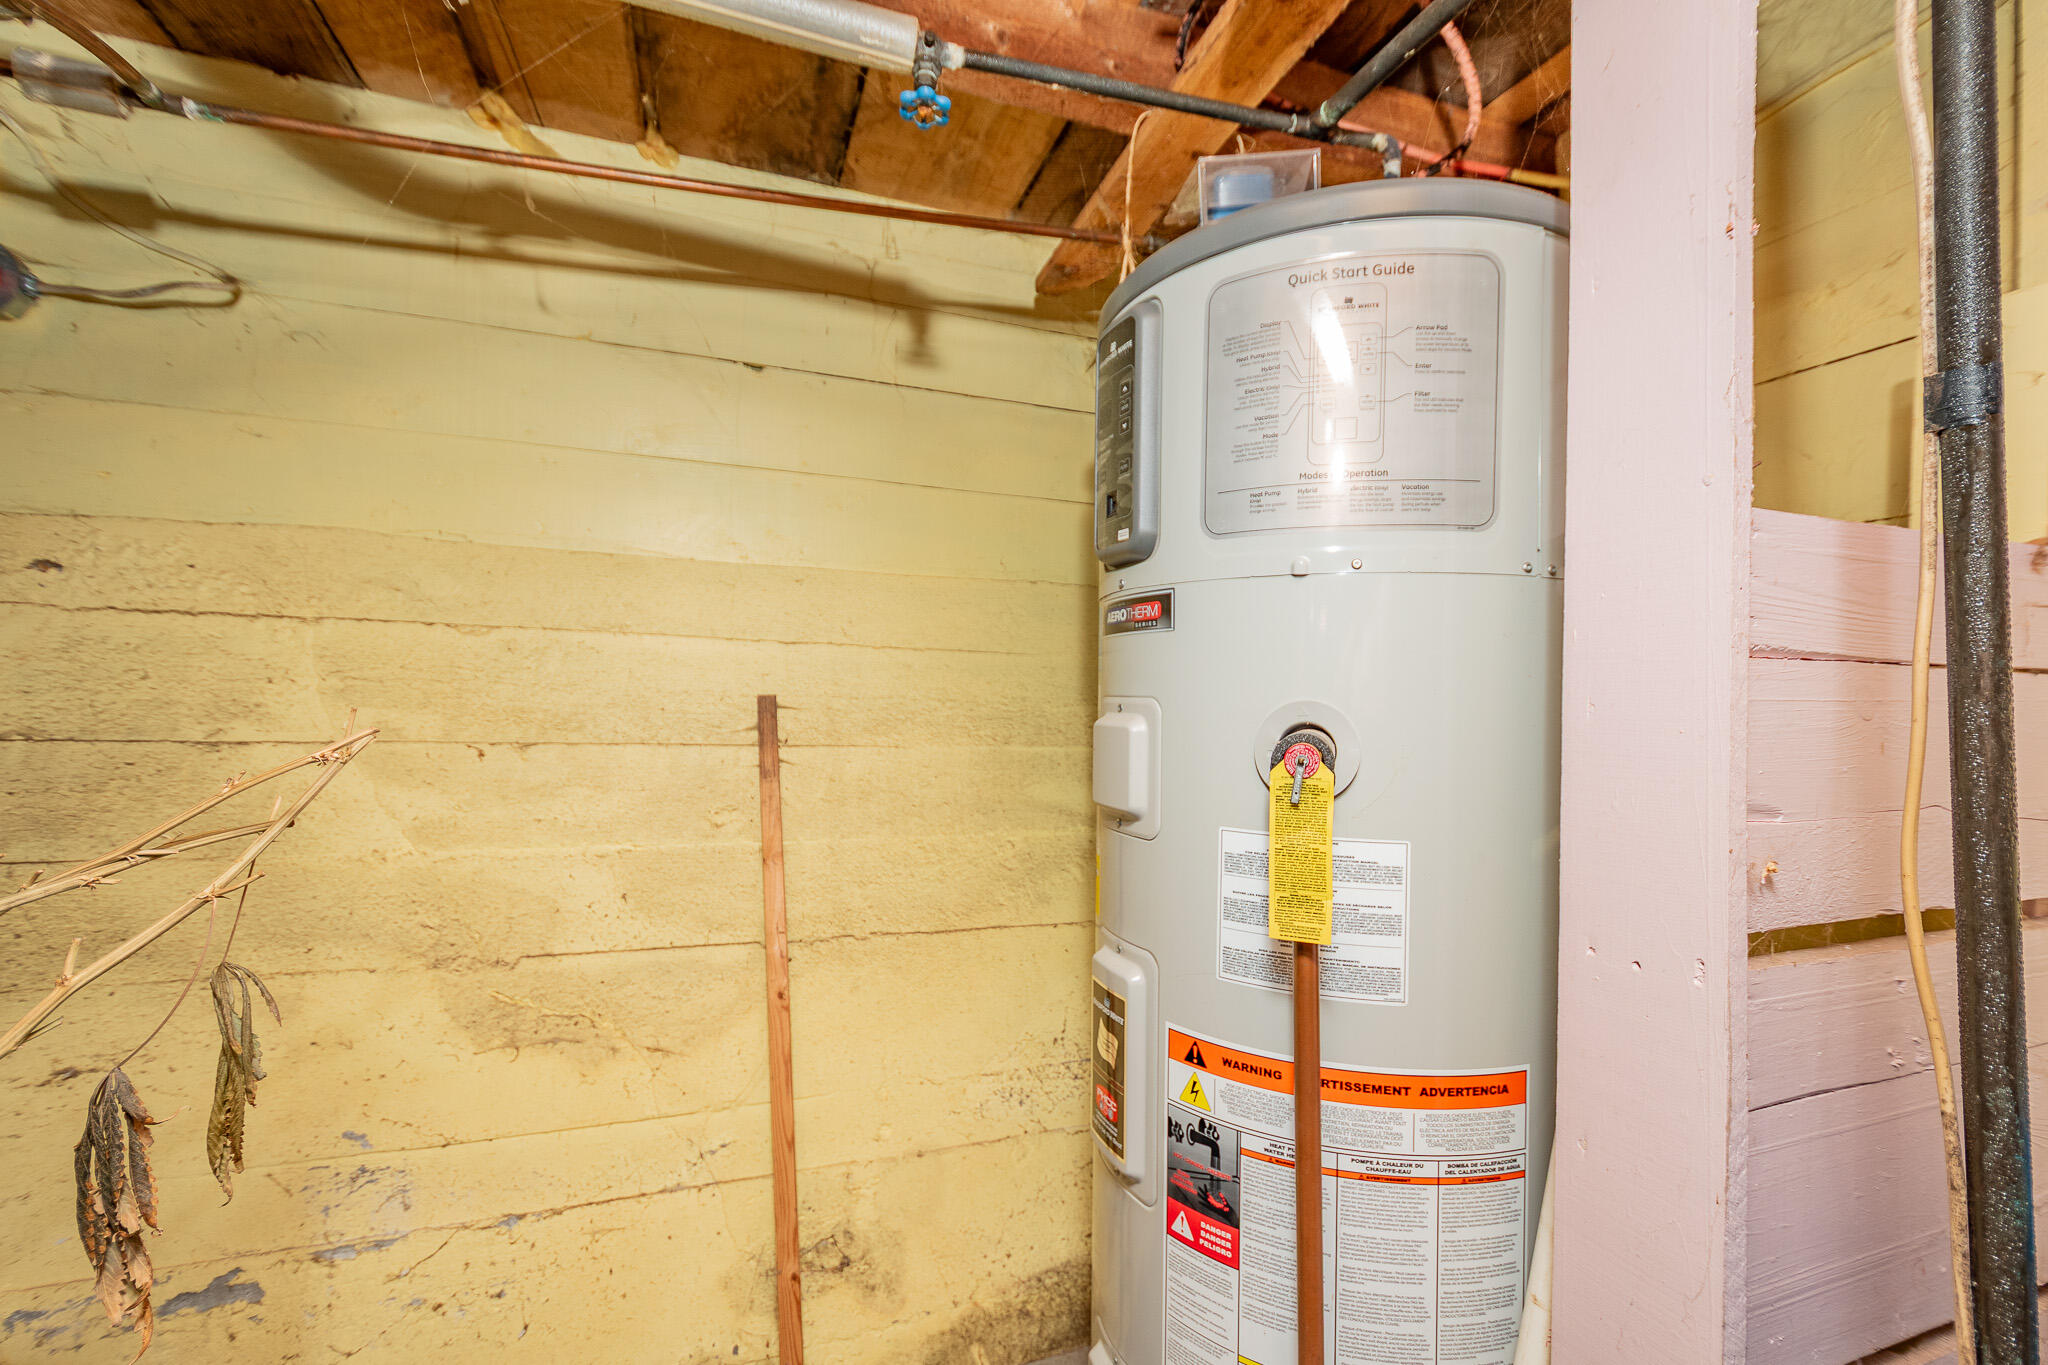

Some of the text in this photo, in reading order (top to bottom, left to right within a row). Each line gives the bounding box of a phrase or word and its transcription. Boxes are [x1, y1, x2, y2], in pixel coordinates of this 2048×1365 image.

[1288, 261, 1415, 287] Quick Start Guide
[1261, 364, 1280, 372] Hybrid
[1244, 386, 1264, 394] Electric
[1299, 472, 1329, 480] Modes
[1297, 487, 1319, 495] Hybrid
[1106, 603, 1160, 624] AEROTHERM
[1135, 620, 1157, 628] SERIES
[1221, 1056, 1282, 1081] WARNING
[1320, 1079, 1509, 1098] RTISSEMENT ADVERTENCIA
[1269, 1142, 1285, 1150] HEAT
[1263, 1147, 1284, 1157] WATER
[1351, 1158, 1374, 1166] POMPE
[1365, 1166, 1412, 1175] CHAUFFE-EAU
[1457, 1167, 1497, 1175] CALENTADOR
[1200, 1220, 1232, 1240] DANGER
[1200, 1230, 1232, 1249] DANGER
[1199, 1238, 1232, 1258] PELIGRO
